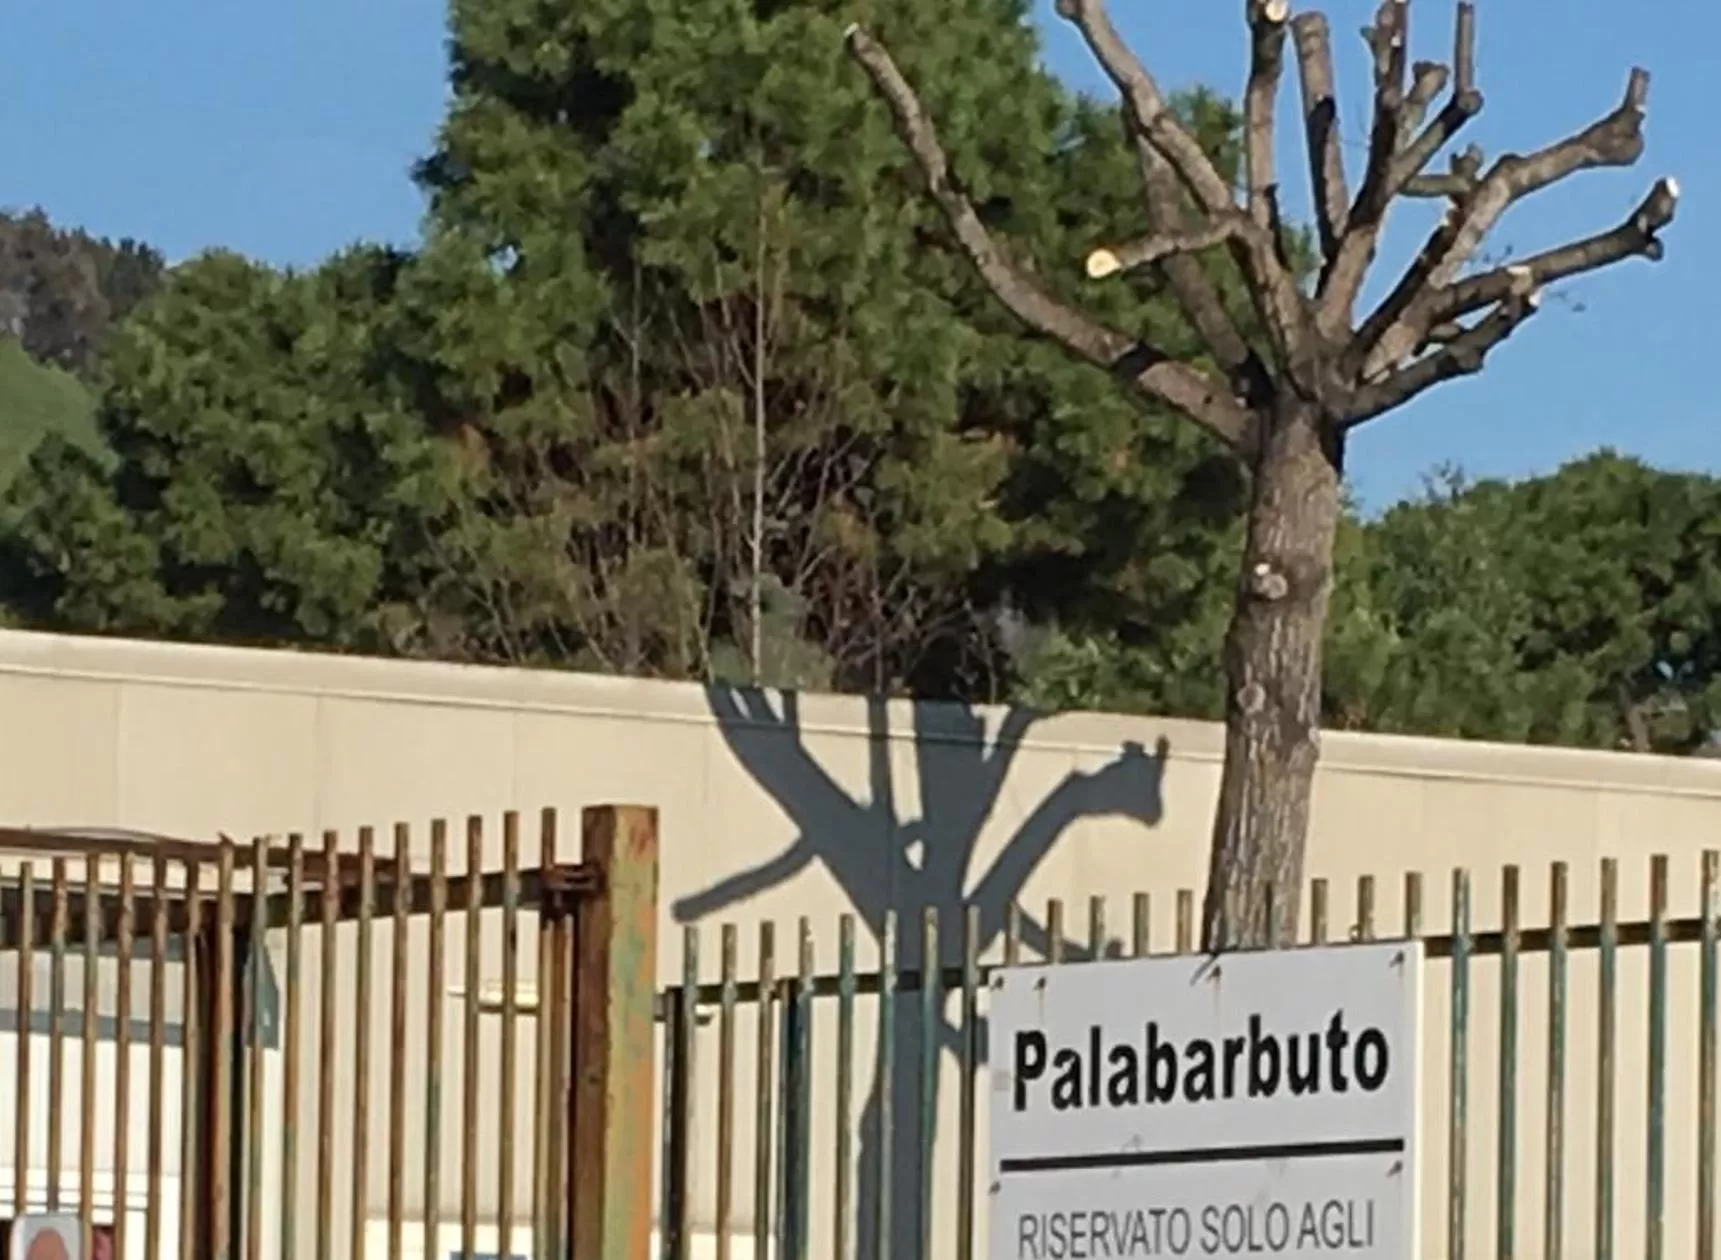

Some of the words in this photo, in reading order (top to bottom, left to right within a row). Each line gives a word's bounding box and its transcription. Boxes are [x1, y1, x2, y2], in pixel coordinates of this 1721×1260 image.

[1013, 1009, 1389, 1112] Palabarbuto
[1018, 1207, 1191, 1260] RISERVATO
[1200, 1202, 1290, 1254] SOLO
[1297, 1199, 1376, 1250] AGLI
